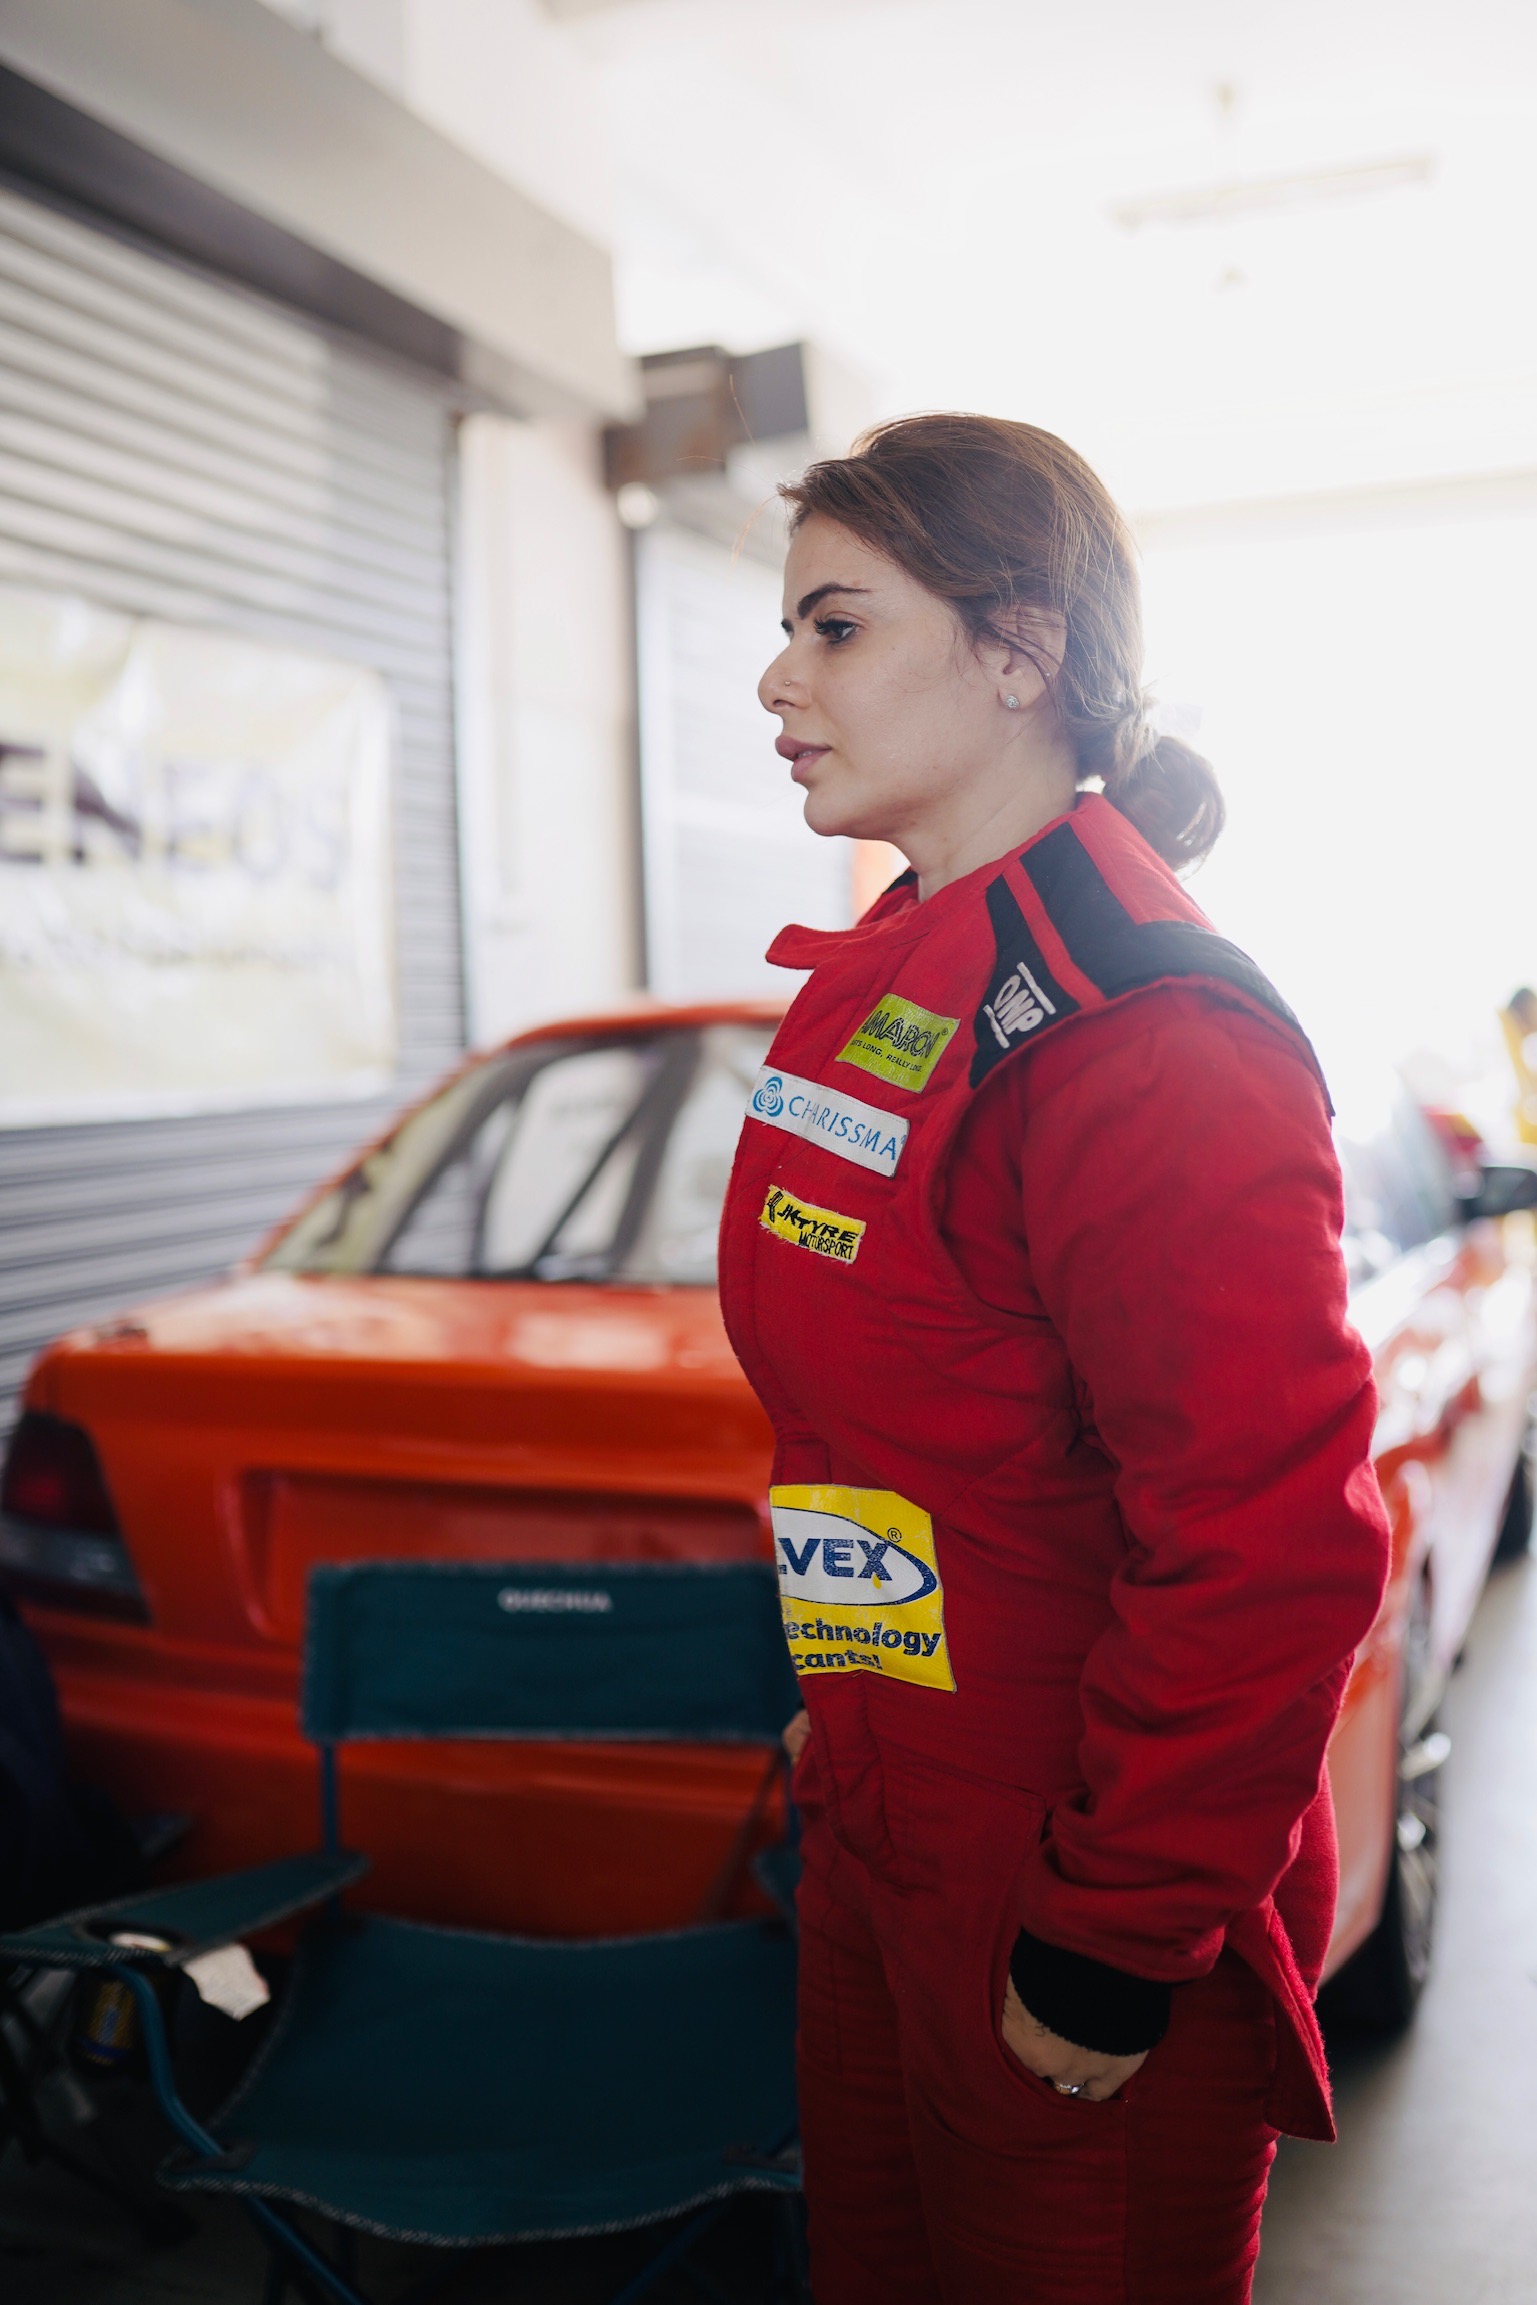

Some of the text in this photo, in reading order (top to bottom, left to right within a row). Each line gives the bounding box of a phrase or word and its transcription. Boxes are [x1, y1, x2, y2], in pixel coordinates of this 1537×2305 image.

[993, 974, 1045, 1036] OMP
[885, 1053, 911, 1068] REALLY
[788, 1095, 897, 1161] CHARISSMA
[799, 1230, 854, 1260] MOTORSPORT
